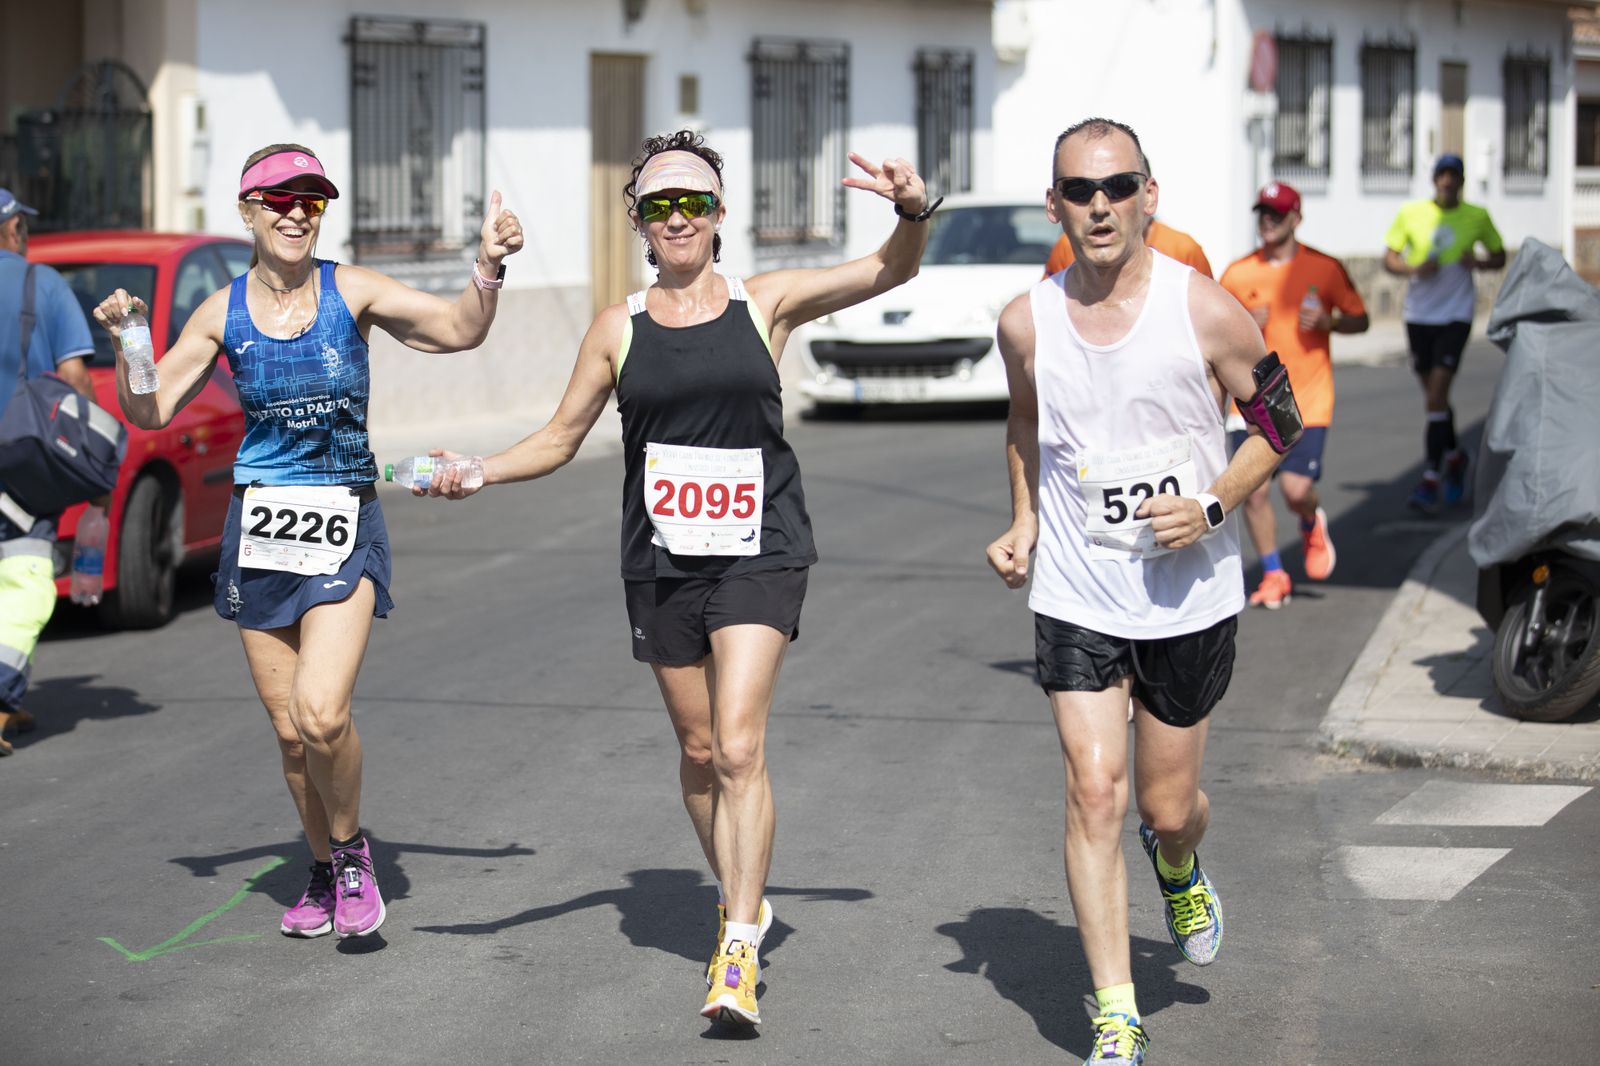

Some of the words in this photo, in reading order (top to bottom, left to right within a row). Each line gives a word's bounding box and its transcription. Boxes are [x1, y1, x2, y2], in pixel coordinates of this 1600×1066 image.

[249, 407, 292, 421] PAZITO
[295, 408, 305, 416] a
[307, 397, 349, 414] PAZITO
[299, 394, 330, 403] Deportiva
[287, 417, 318, 429] Motril
[652, 479, 756, 519] 2095
[248, 506, 349, 546] 2226
